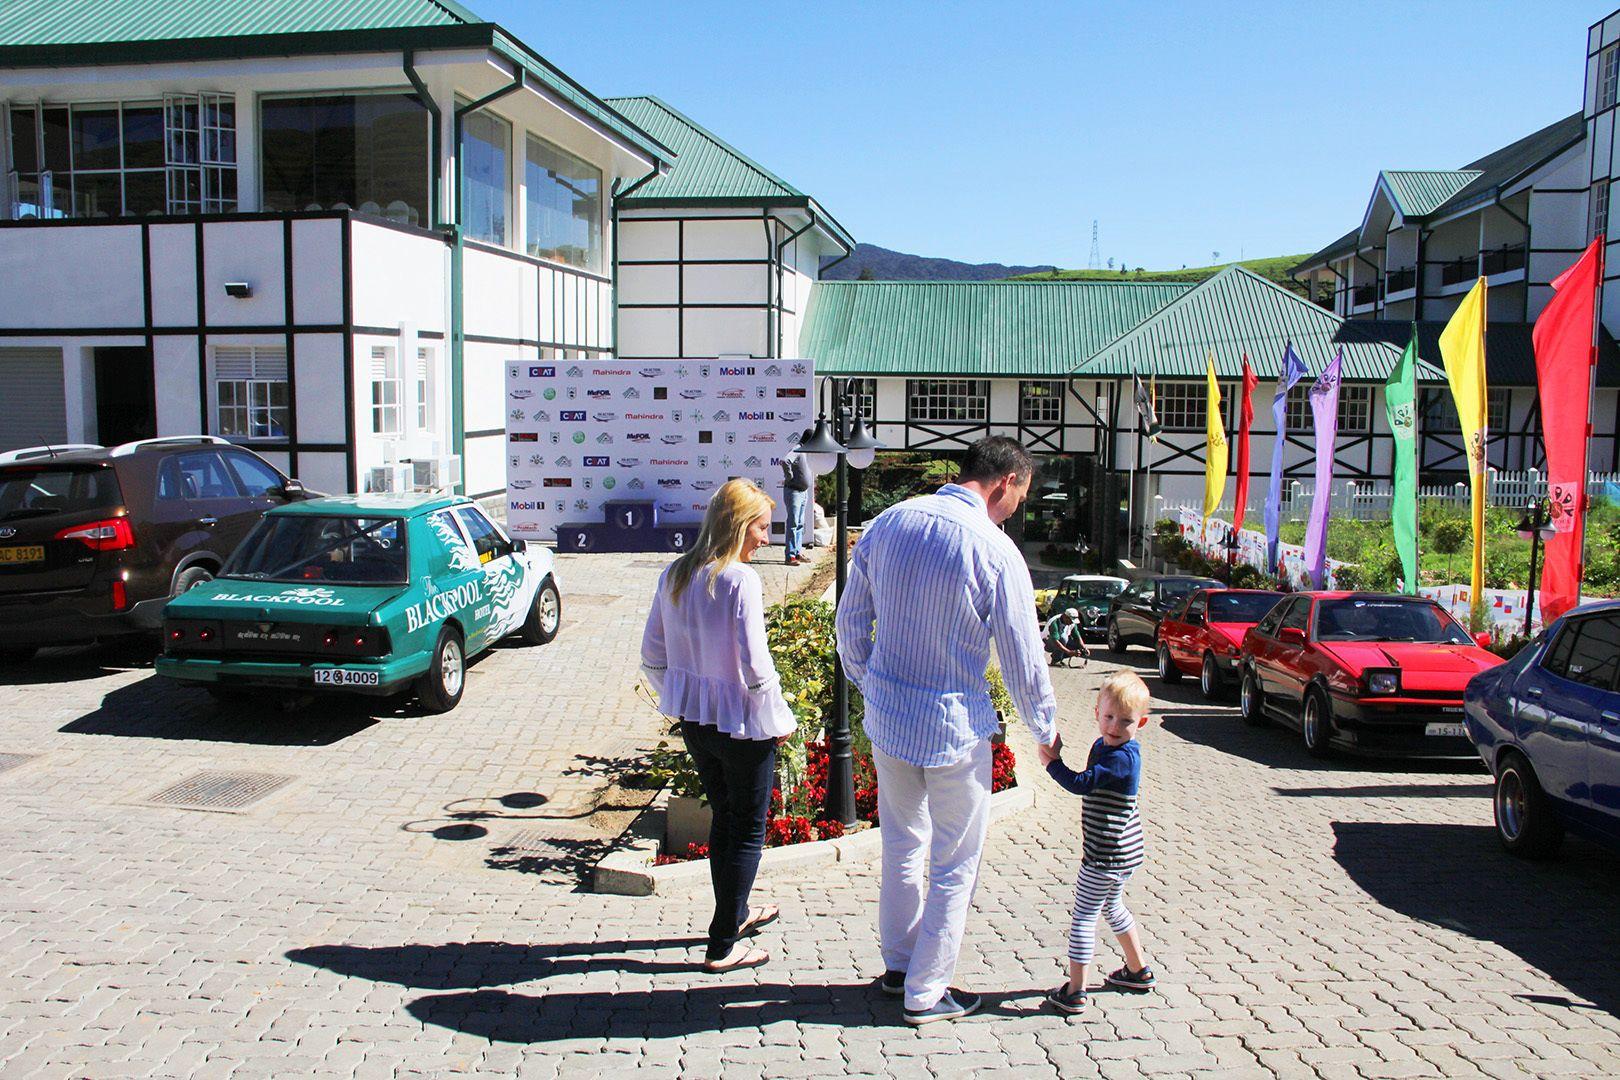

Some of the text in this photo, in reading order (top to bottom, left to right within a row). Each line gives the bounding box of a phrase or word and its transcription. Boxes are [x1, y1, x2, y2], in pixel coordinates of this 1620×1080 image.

[719, 367, 745, 376] Mobil
[738, 412, 764, 421] Mobil
[511, 501, 536, 510] Mobil
[625, 511, 633, 526] 1
[577, 533, 587, 548] 2
[674, 532, 684, 548] 3
[16, 547, 44, 560] 8191
[210, 591, 346, 606] BLACKPOOL
[404, 577, 483, 634] BLACKPOOL
[315, 670, 330, 682] 12
[345, 672, 377, 684] 4009
